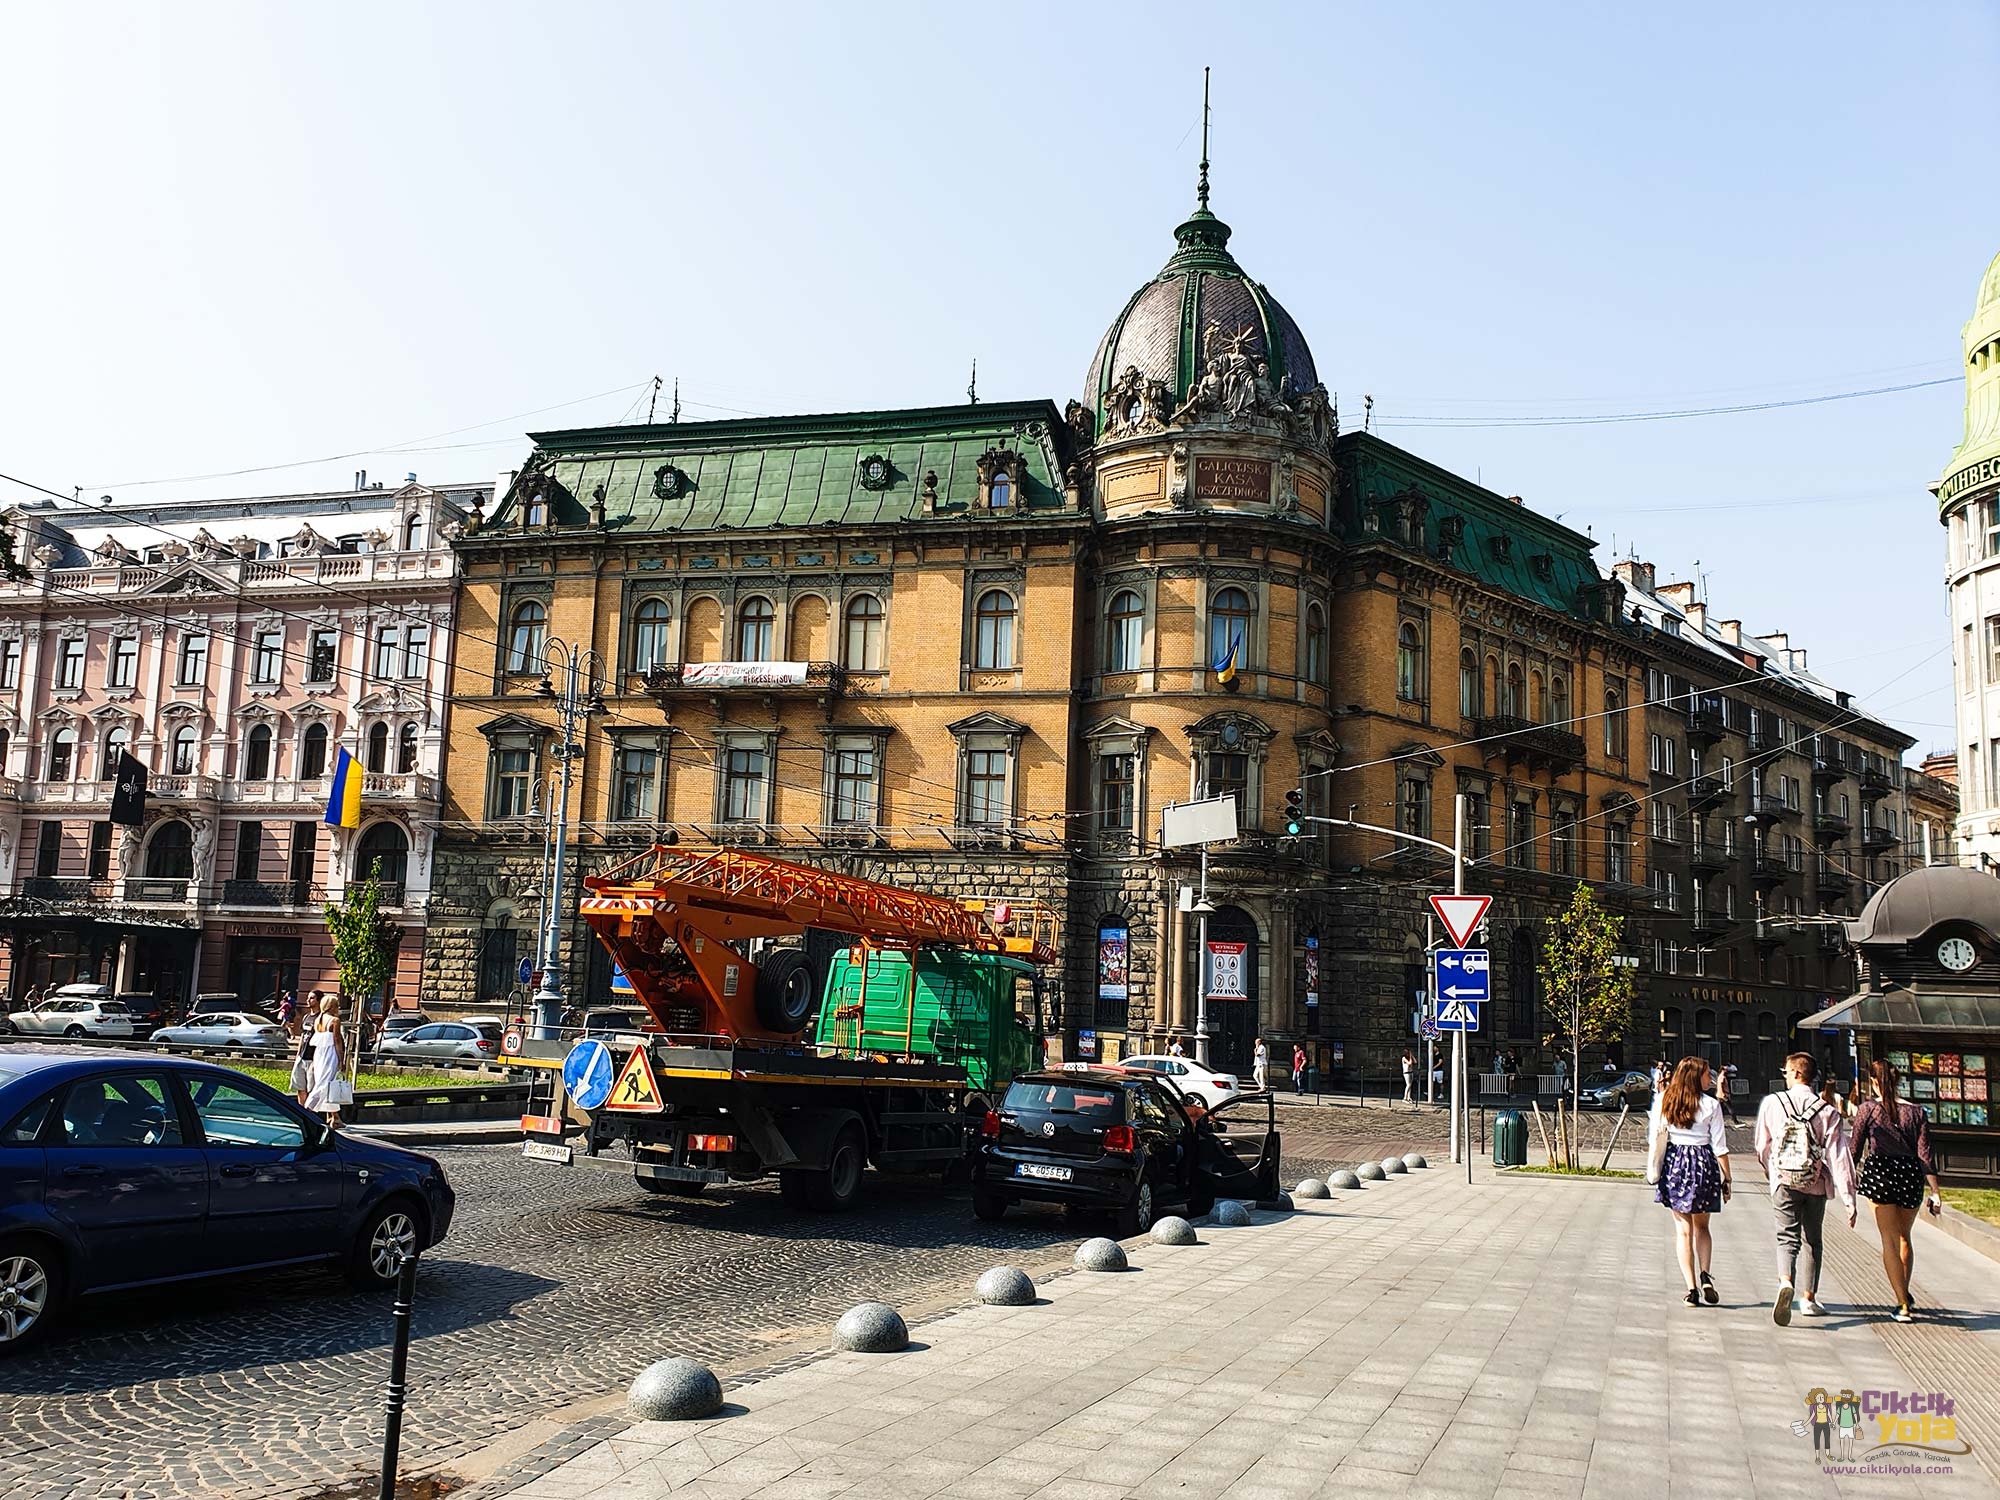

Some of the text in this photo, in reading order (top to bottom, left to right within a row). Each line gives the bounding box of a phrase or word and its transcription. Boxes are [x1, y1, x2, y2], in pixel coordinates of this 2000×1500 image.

[1199, 461, 1269, 477] GALICYJSKA
[1214, 472, 1255, 486] KASA
[507, 1037, 518, 1049] 60
[1023, 1164, 1035, 1174] BC
[1056, 1168, 1068, 1178] EX
